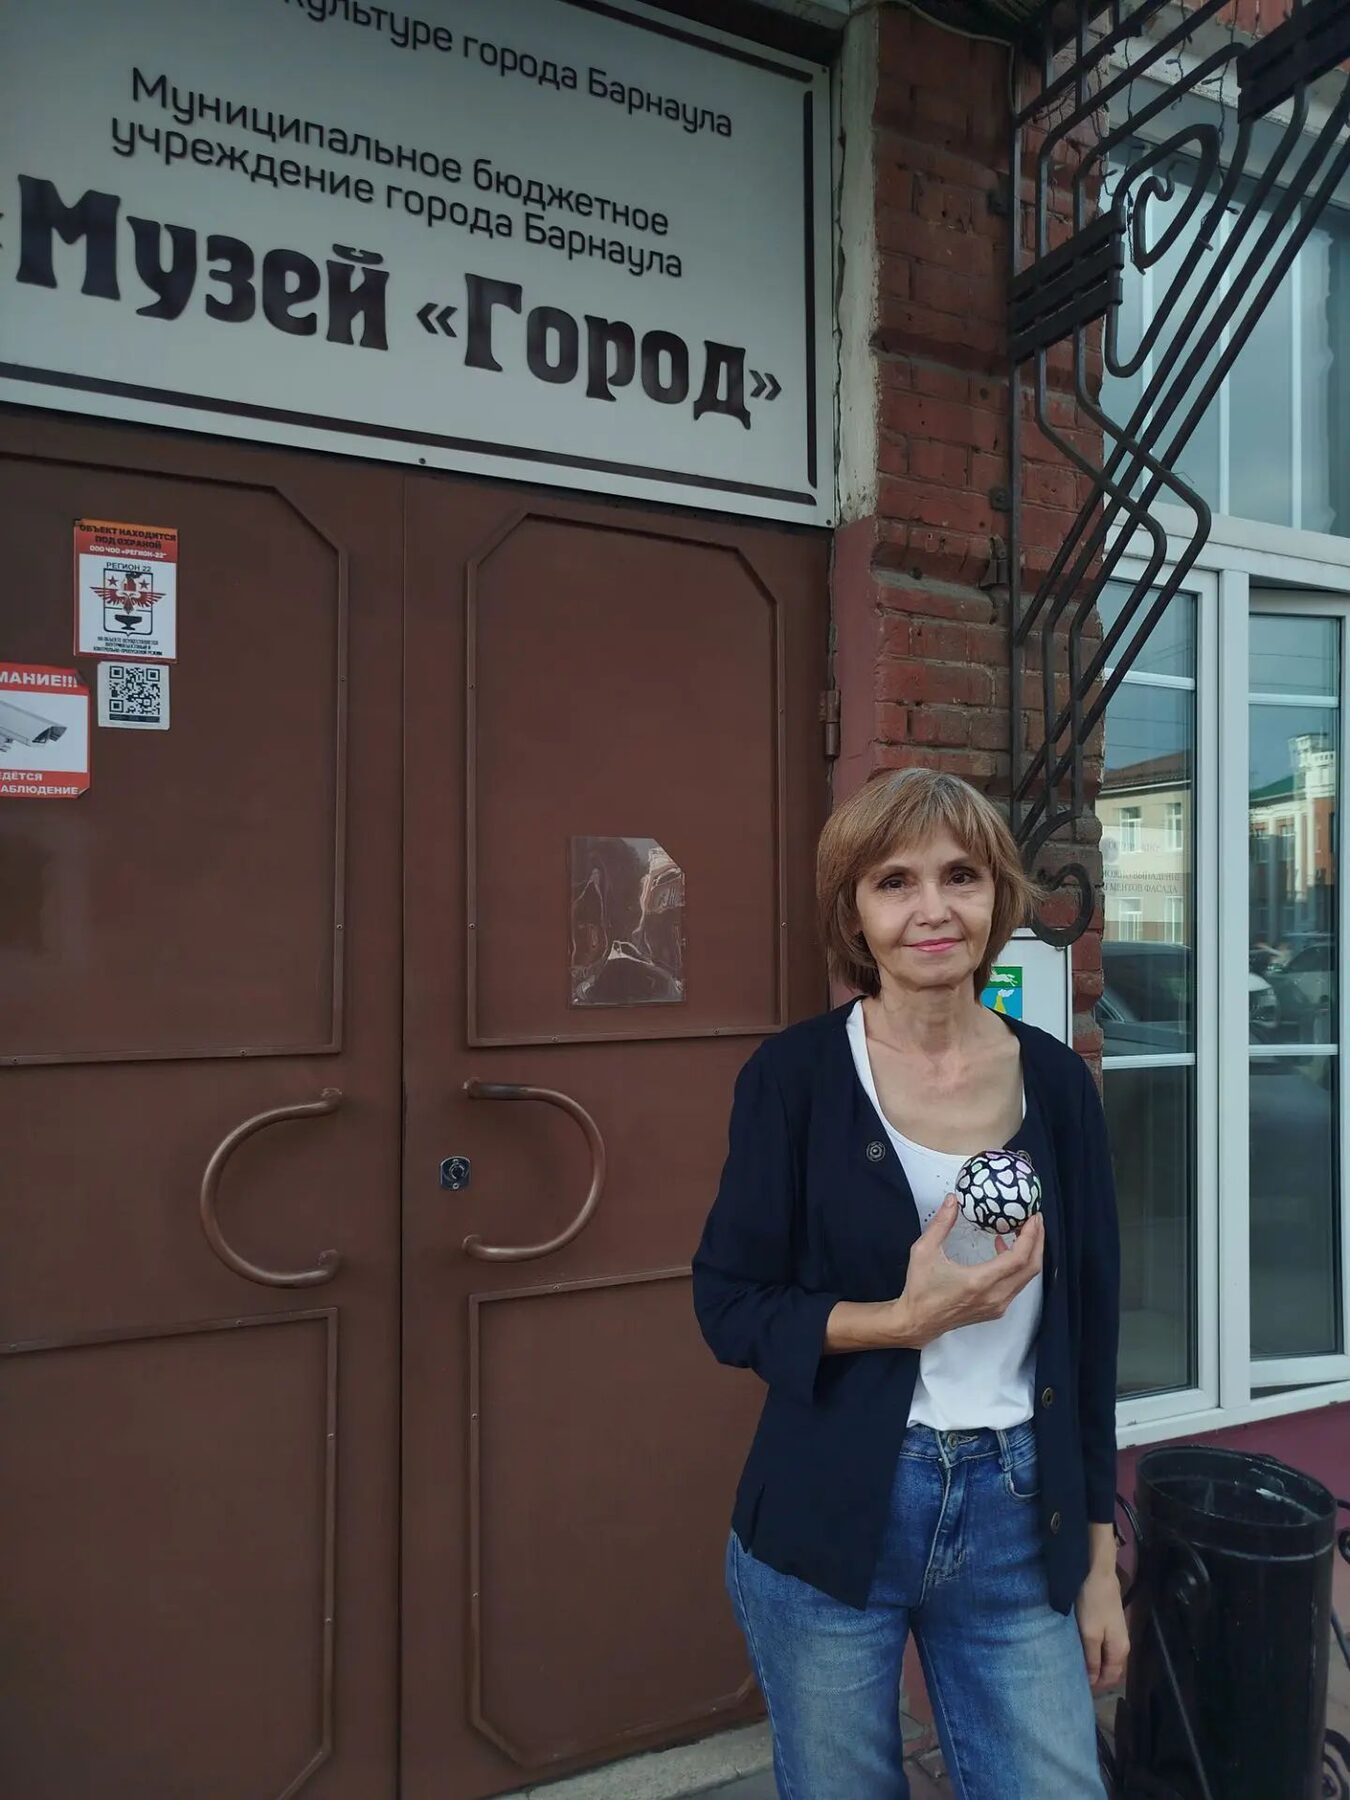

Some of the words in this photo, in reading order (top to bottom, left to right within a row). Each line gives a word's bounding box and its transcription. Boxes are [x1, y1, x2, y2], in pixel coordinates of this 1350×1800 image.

[285, 0, 454, 52] ультуре
[463, 36, 578, 91] города
[587, 66, 733, 137] Барнаула
[132, 66, 462, 184] Муниципальное
[473, 158, 669, 236] бюджетное
[111, 117, 374, 204] учреждение
[386, 184, 512, 239] города
[524, 211, 682, 278] Барнаула
[416, 272, 783, 431] «Город»
[79, 524, 117, 534] ОБЪЕКТ
[119, 528, 176, 541] НАХОДИТСЯ
[95, 535, 116, 545] ПОД
[117, 538, 162, 549] ОХРАНОЙ
[106, 561, 140, 571] РЕГИОН
[142, 563, 152, 572] 22
[1144, 883, 1179, 895] ФАСАДА
